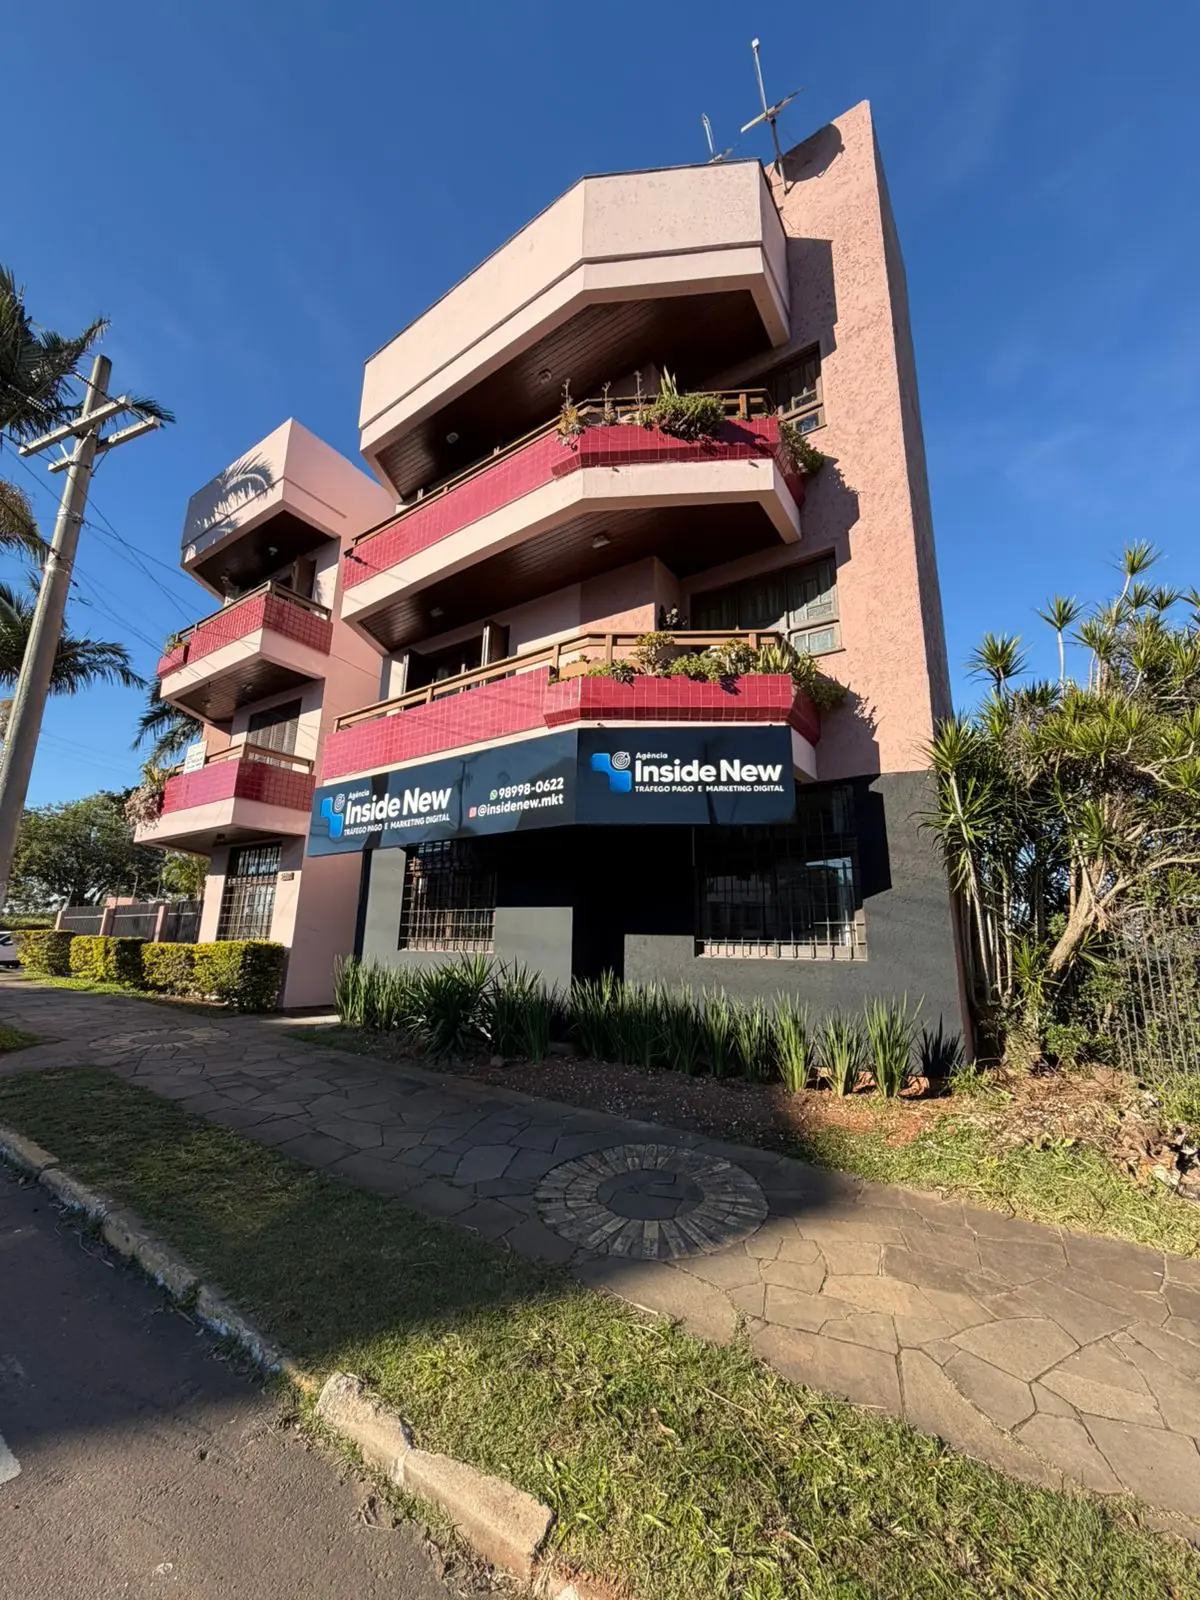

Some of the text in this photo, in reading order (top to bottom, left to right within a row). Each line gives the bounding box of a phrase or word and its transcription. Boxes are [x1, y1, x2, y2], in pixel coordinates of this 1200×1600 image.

[636, 752, 668, 760] Agência
[635, 759, 783, 783] Inside New
[348, 789, 370, 801] Agência
[498, 777, 564, 800] 98998-0622
[635, 784, 784, 793] TRÁFEGO PAGO E MARKETING DIGITAL
[345, 787, 452, 825] Inside New
[478, 794, 564, 818] @insidenew.mkt
[344, 825, 366, 836] TRÁFEGO
[367, 823, 382, 833] PAGO
[390, 817, 424, 829] MARKETING
[425, 812, 450, 826] DIGITAL
